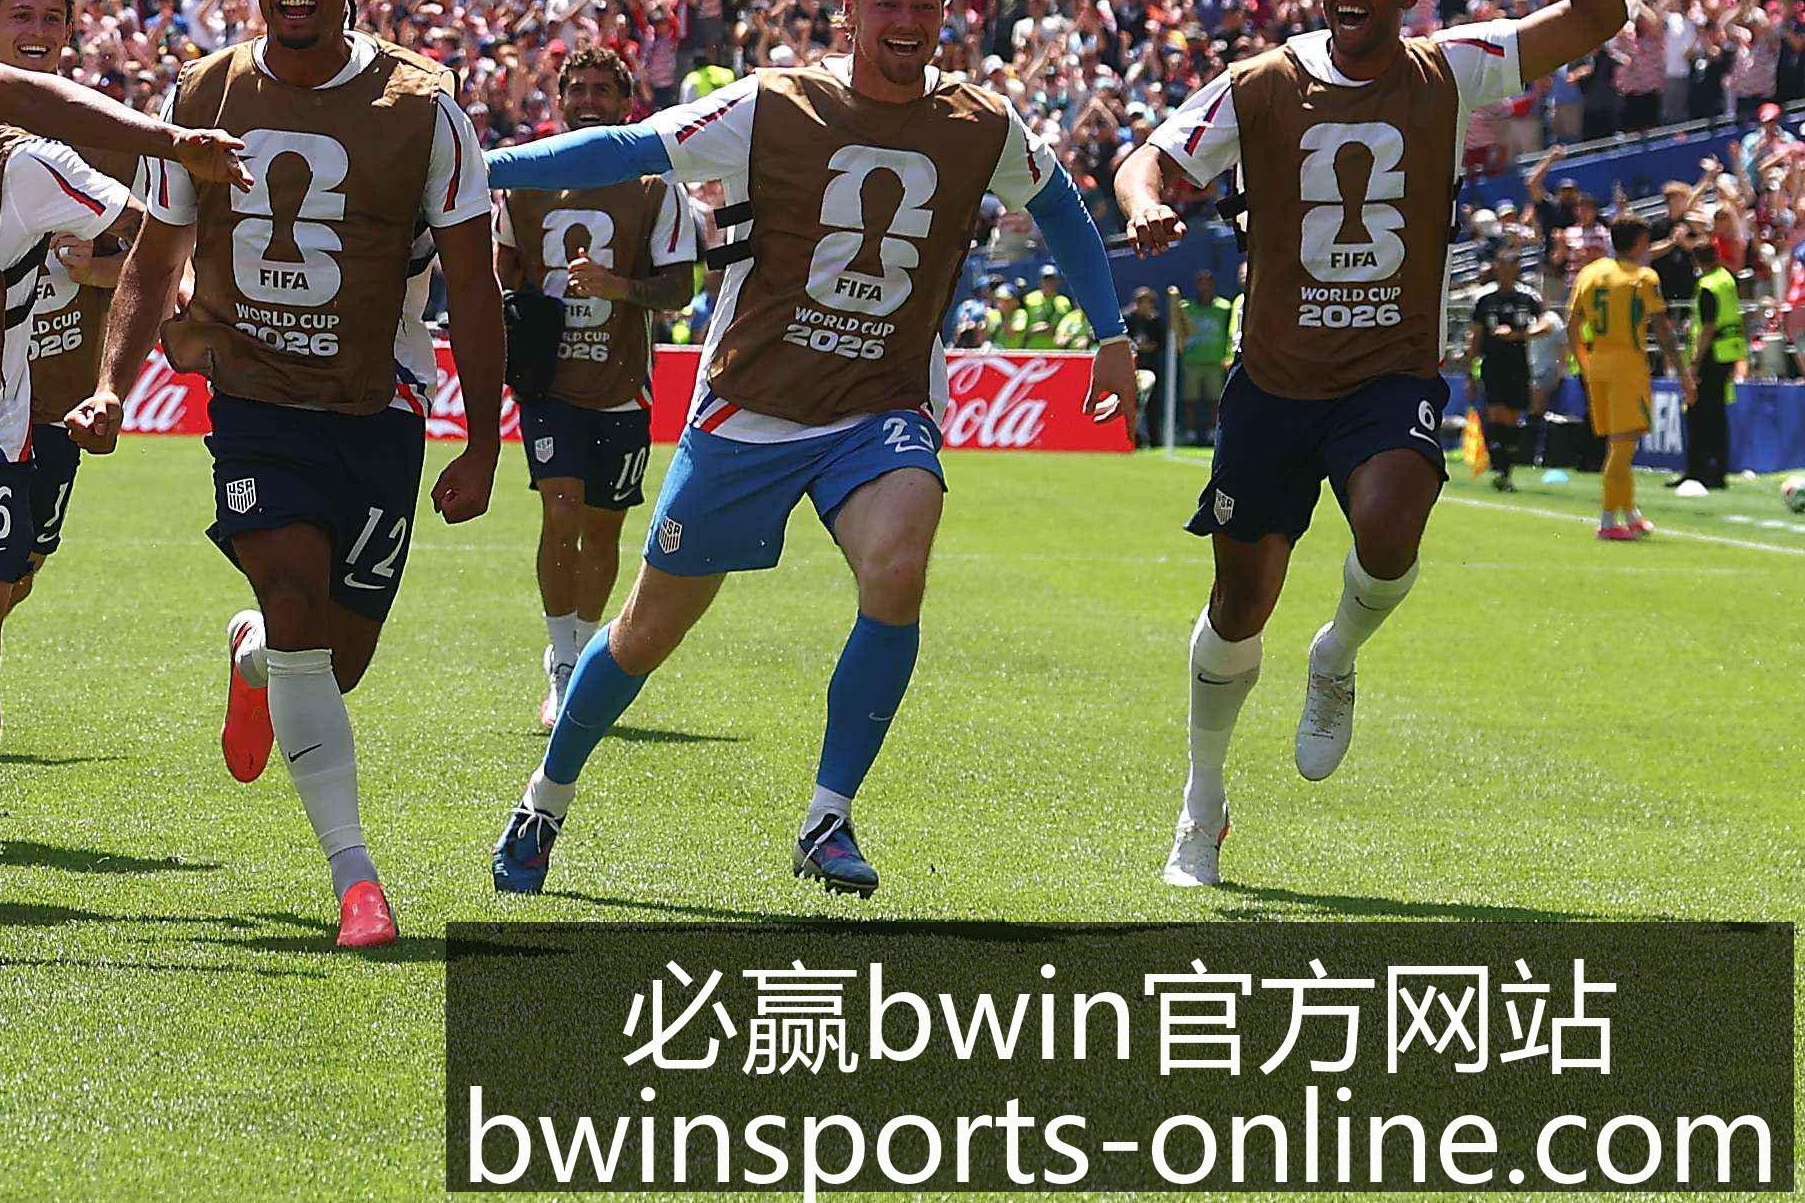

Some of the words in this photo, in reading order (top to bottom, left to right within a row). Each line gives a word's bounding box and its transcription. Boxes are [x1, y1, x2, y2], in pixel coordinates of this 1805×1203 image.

[1330, 252, 1377, 268] FIFA
[259, 268, 310, 290] FIFA
[834, 277, 883, 302] FIFA
[1300, 286, 1365, 302] WORLD
[1368, 286, 1402, 301] CUP
[52, 310, 82, 331] CUP
[235, 302, 296, 327] WORLD
[299, 314, 340, 329] CUP
[795, 306, 859, 332] WORLD
[860, 321, 895, 337] CUP
[1299, 303, 1402, 328] 2026
[1593, 288, 1609, 337] 5
[28, 327, 83, 361] 026
[584, 331, 611, 343] CUP
[782, 324, 885, 360] 2026
[556, 342, 609, 363] 026
[1418, 399, 1436, 432] 6
[615, 447, 646, 491] 10
[228, 479, 254, 495] USA
[345, 507, 407, 578] 12
